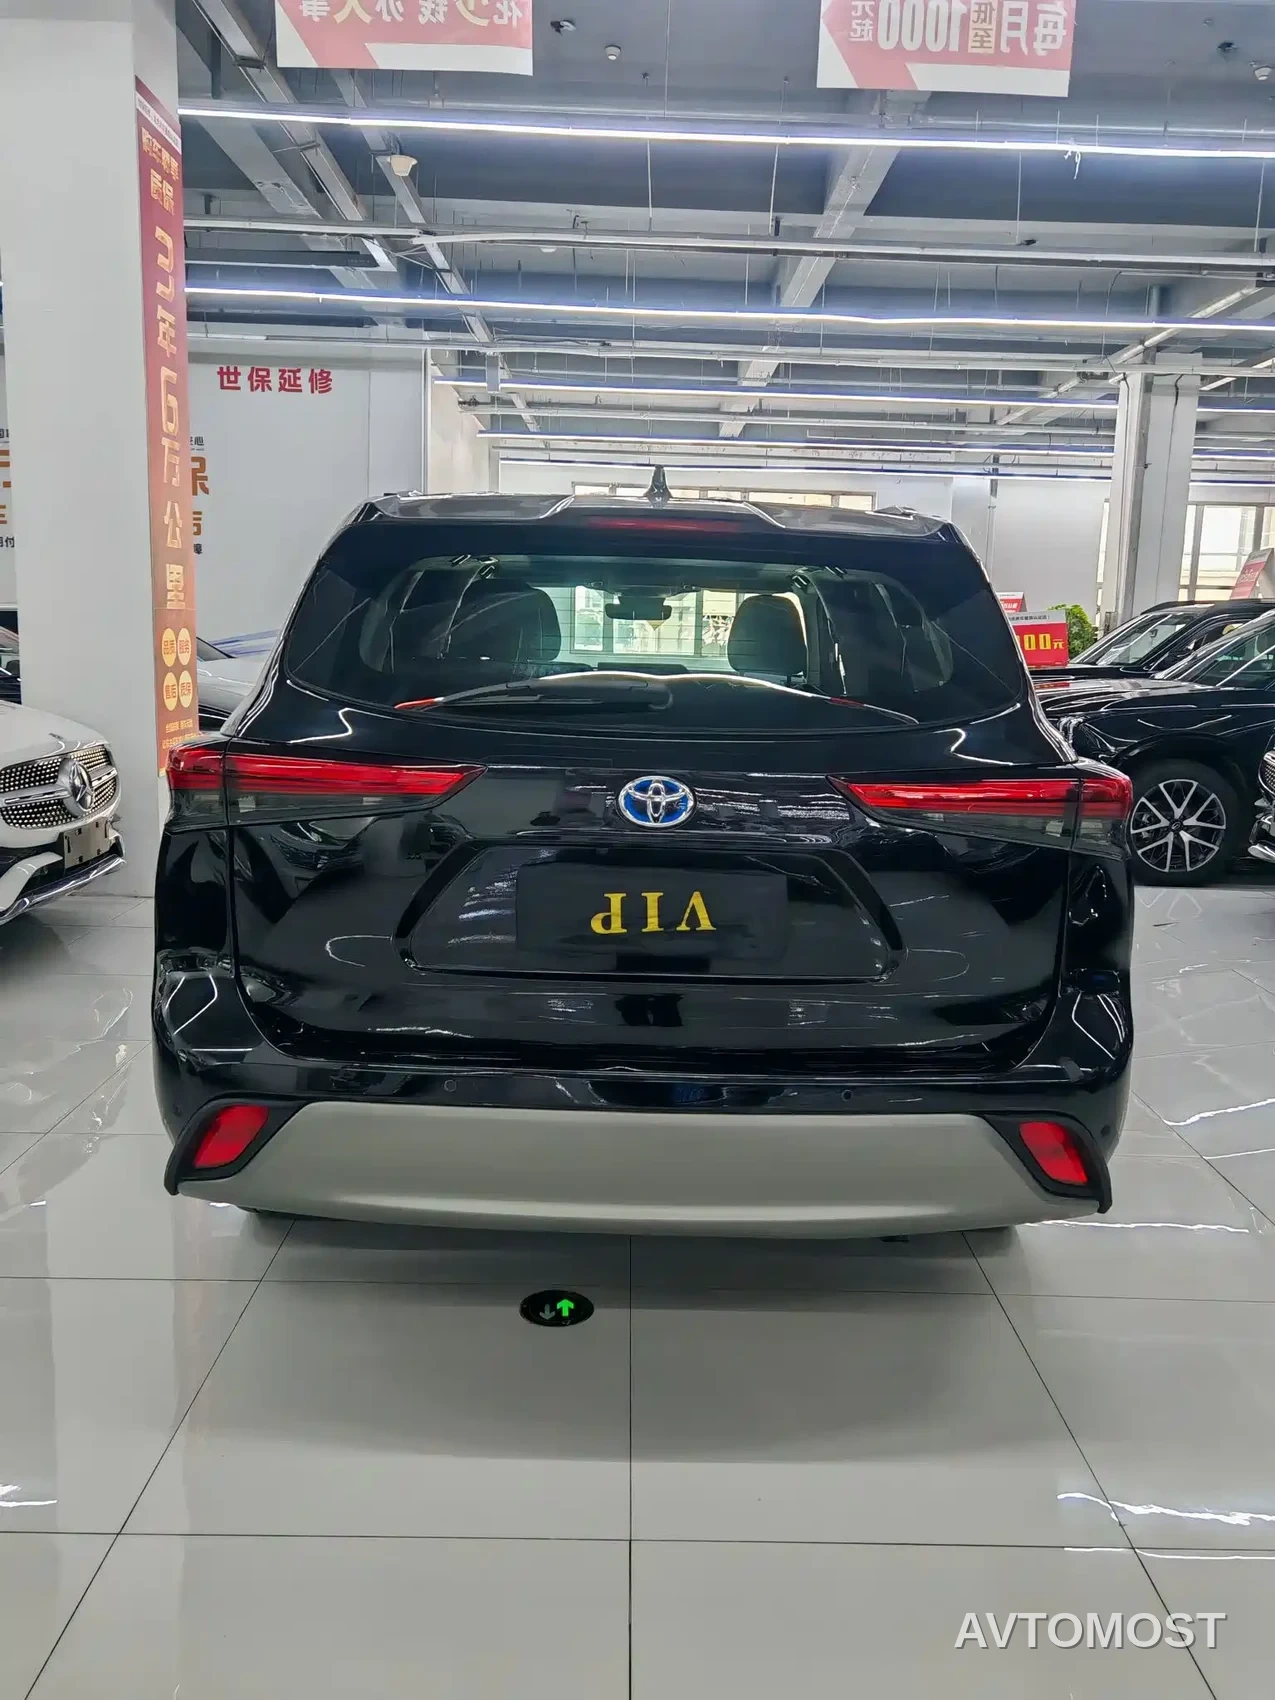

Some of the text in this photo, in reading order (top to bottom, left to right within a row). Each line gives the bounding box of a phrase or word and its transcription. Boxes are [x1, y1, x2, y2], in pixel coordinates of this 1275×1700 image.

[217, 366, 333, 394] 世保延修
[590, 891, 716, 935] VIP
